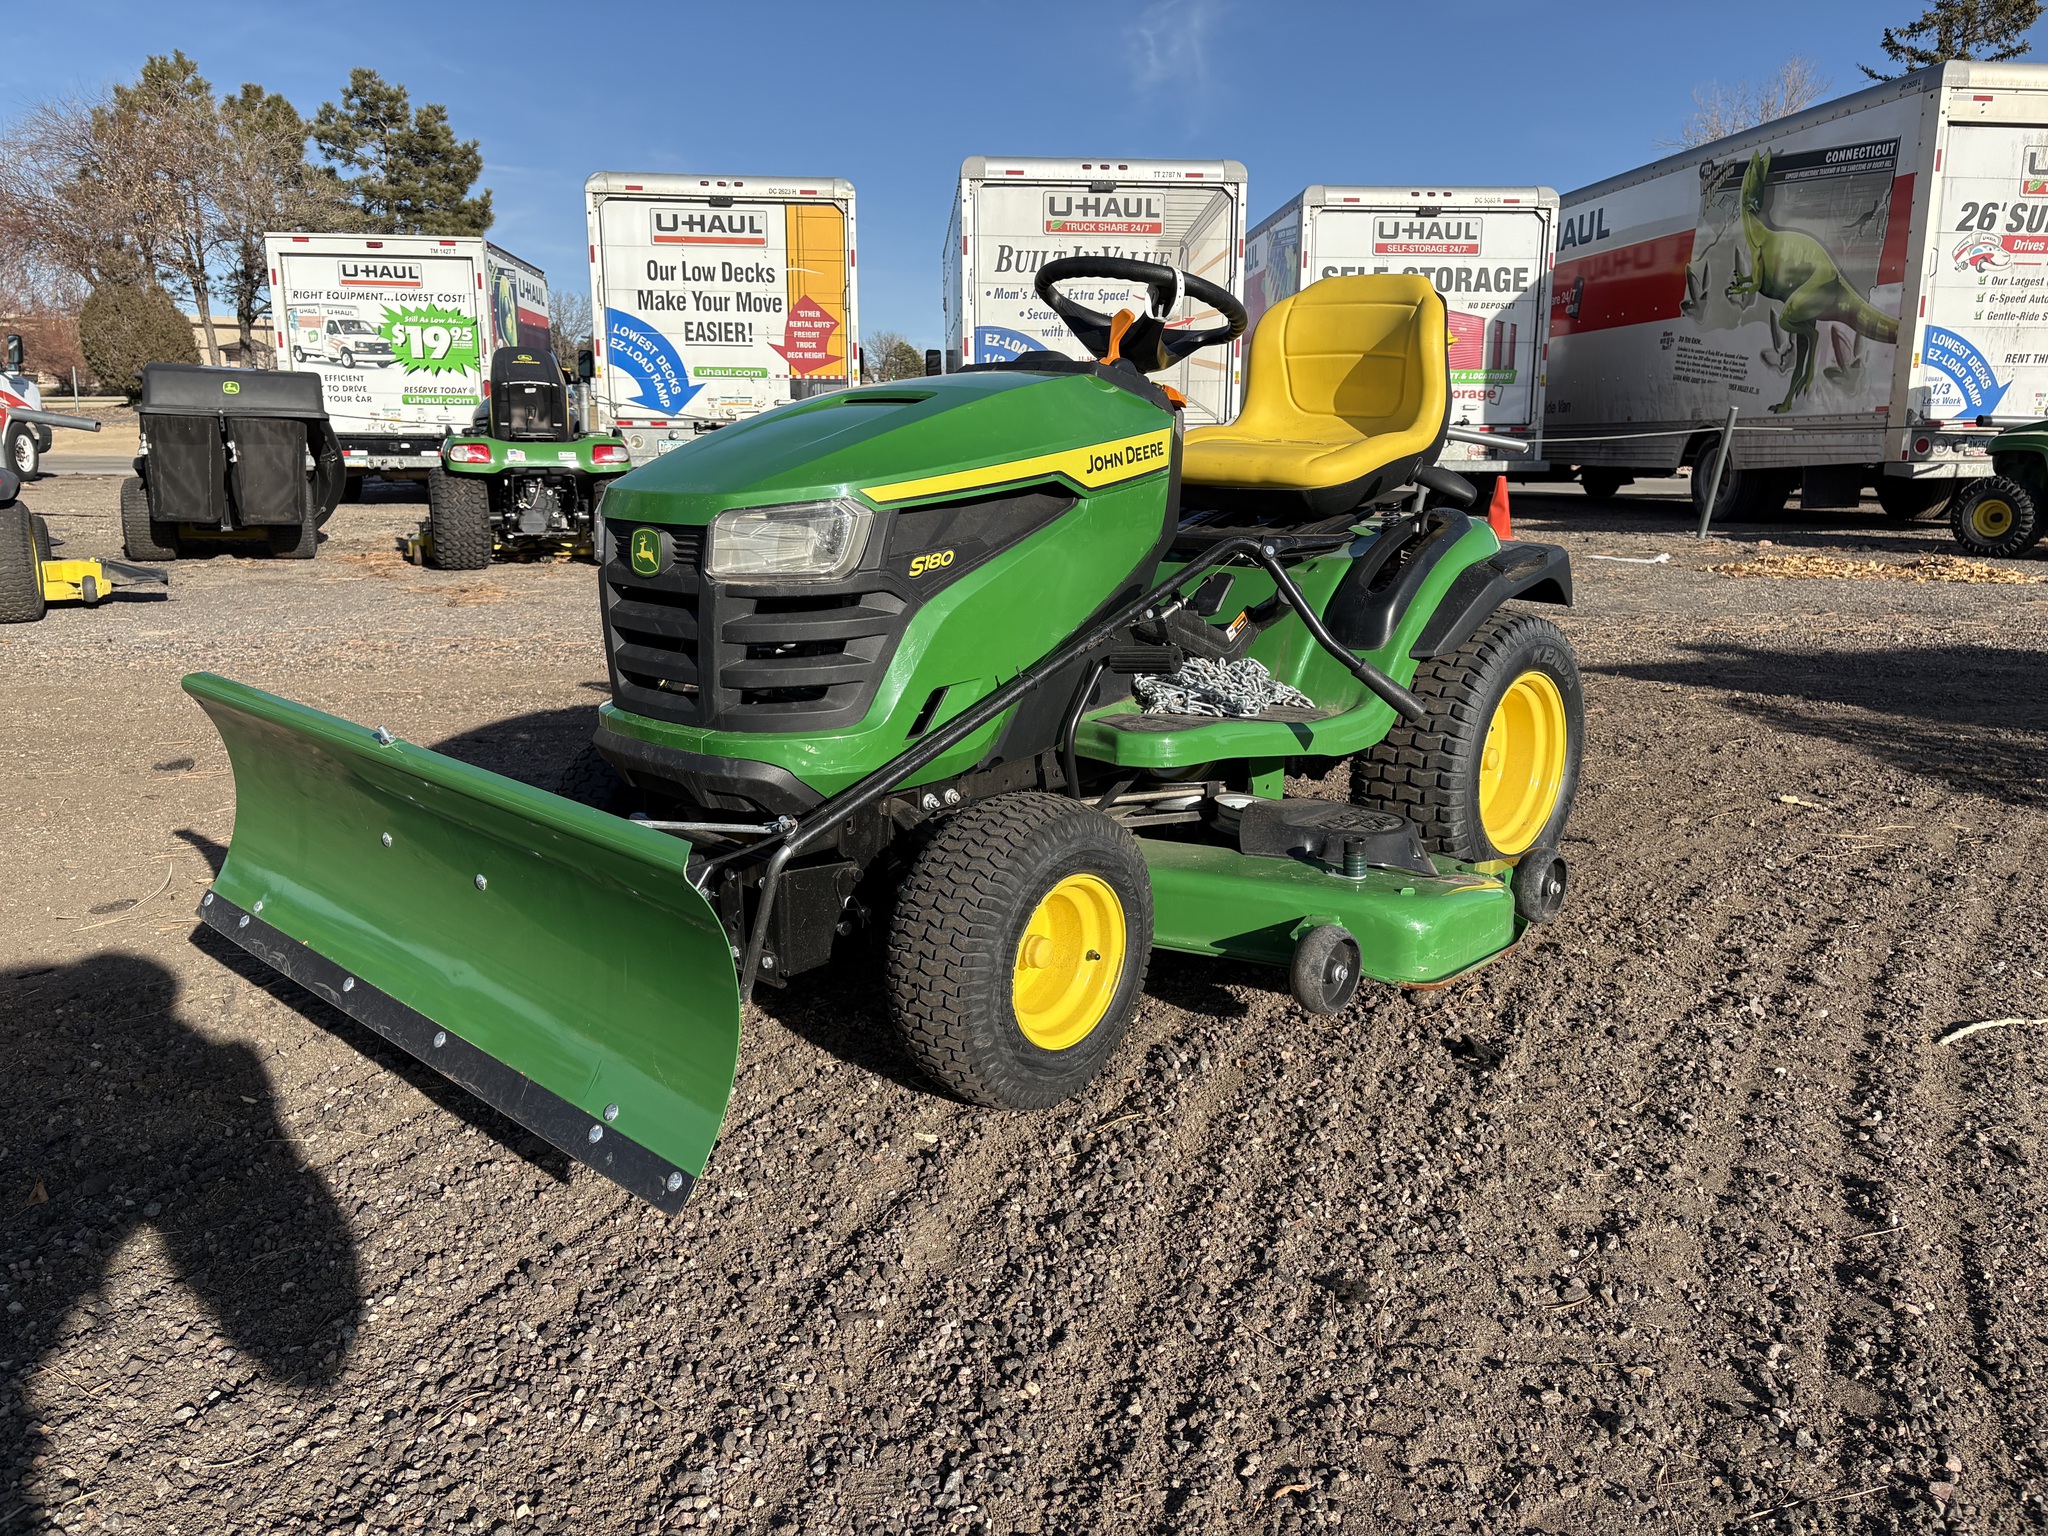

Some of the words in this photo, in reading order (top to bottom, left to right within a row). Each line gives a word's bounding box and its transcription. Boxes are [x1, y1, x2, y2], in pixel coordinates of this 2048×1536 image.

[1825, 142, 1896, 163] CONNECTICUT
[1049, 196, 1160, 218] U-HAUL
[655, 213, 763, 234] U-HAUL
[1065, 222, 1097, 231] TRUCK
[1099, 223, 1128, 232] SHARE
[1131, 224, 1150, 232] 24/7
[1378, 221, 1478, 240] U-HAUL
[1387, 244, 1447, 253] SELF-STORAGE
[1449, 245, 1465, 253] 24/7
[2013, 239, 2045, 252] Drives
[342, 264, 419, 279] U-HAUL
[647, 260, 676, 281] Our
[682, 261, 716, 282] Low
[722, 262, 775, 283] Decks
[1991, 276, 2008, 286] Our
[2010, 276, 2044, 288] Largest
[293, 291, 322, 299] RIGHT
[437, 294, 466, 302] COST!
[994, 287, 1028, 300] Mom's
[1068, 288, 1094, 300] Extra
[1098, 289, 1129, 303] Space!
[1551, 295, 1560, 304] are
[1562, 288, 1577, 304] 24/7
[1989, 294, 2027, 305] 6-Speed
[637, 290, 687, 311] Make
[692, 291, 730, 312] Your
[737, 292, 782, 313] Move
[1480, 302, 1515, 310] DEPOSIT!
[1027, 308, 1058, 320] Secure
[1987, 311, 2040, 321] Gentle-Ride
[684, 322, 753, 343] EASIER!
[1042, 325, 1063, 337] with
[985, 333, 1035, 354] EZ-LOA
[613, 323, 659, 355] LOWEST
[656, 355, 681, 395] DECKS
[1932, 332, 1971, 359] LOWEST
[1967, 356, 1992, 390] DECKS
[2004, 354, 2031, 364] RENT
[610, 338, 654, 373] EZ-LOAD
[651, 373, 670, 408] RAMP
[699, 368, 762, 376] uhaul.com
[1927, 347, 1967, 378] EZ-LOAD
[1963, 376, 1982, 407] RAMP
[1452, 390, 1496, 401] orage
[1932, 383, 1951, 396] 1/3
[408, 396, 474, 404] uhaul.com
[1558, 400, 1571, 414] Van
[1922, 397, 1940, 405] Less
[1942, 397, 1962, 405] Work
[1086, 452, 1123, 474] JOHN
[1126, 441, 1164, 465] DEERE
[908, 550, 954, 578] S180
[1531, 646, 1575, 690] KENDA
